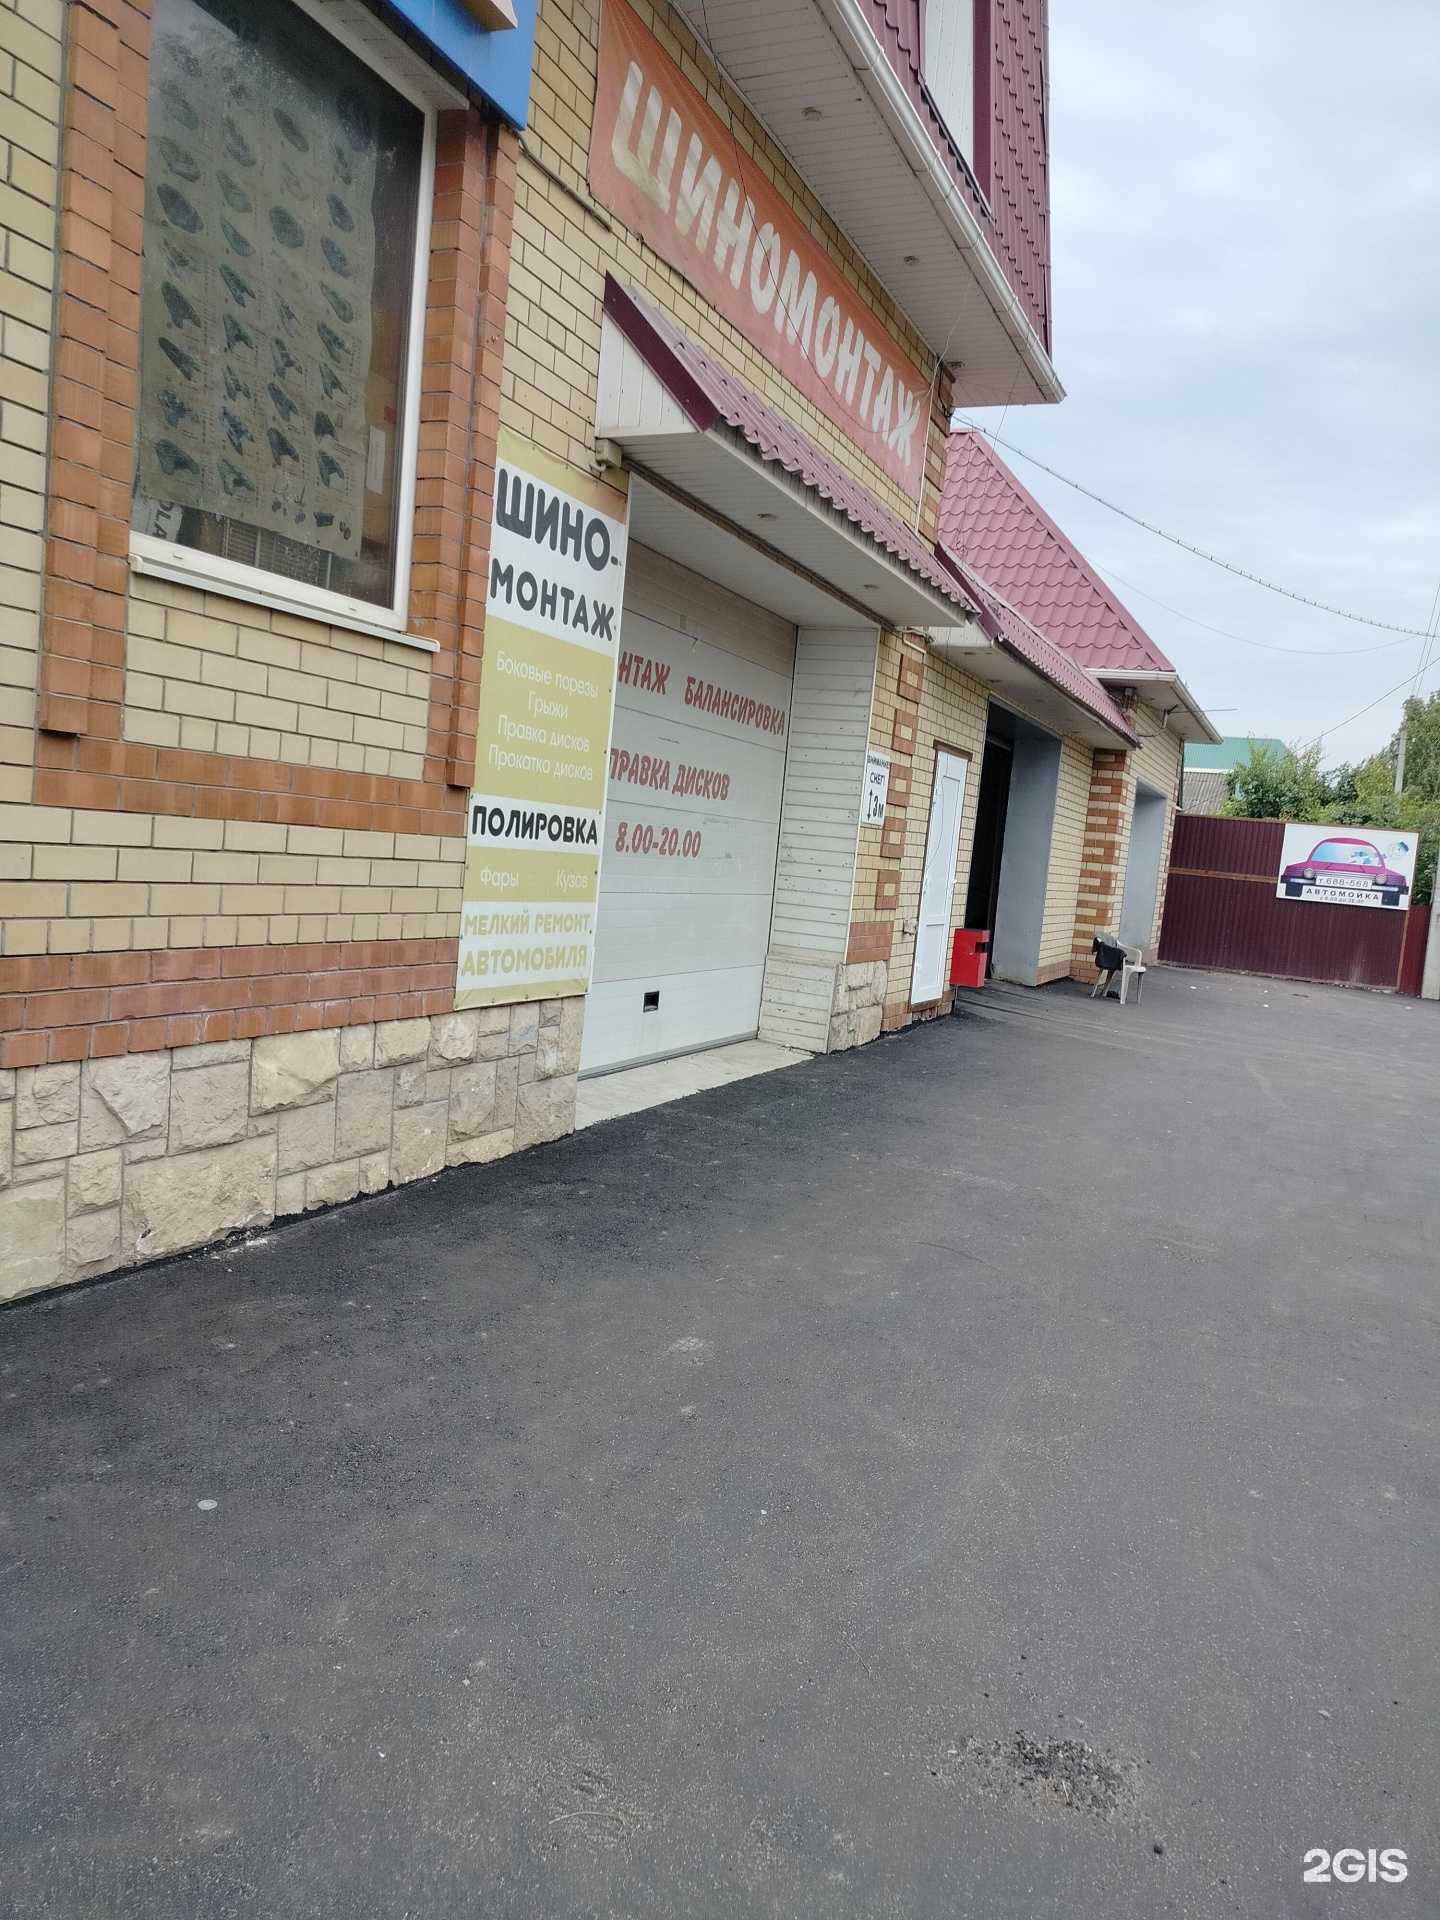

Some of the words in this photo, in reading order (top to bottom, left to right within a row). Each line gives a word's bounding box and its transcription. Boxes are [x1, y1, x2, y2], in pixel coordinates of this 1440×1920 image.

[612, 60, 921, 466] ШИНОМОНТАЖ
[496, 468, 618, 571] ШИНО-
[490, 558, 615, 641] МОНТАЖ
[496, 650, 552, 685] Боковые
[555, 673, 599, 698] порезы
[528, 690, 568, 718] Грыжи
[684, 676, 786, 736] БАЛАНСИРОВКА
[498, 714, 546, 745] Правка
[550, 732, 590, 752] дисков
[488, 743, 551, 771] Прокатка
[553, 763, 593, 781] дисков
[610, 748, 670, 791] ПРАВКА
[671, 764, 730, 801] ДИСКОВ
[472, 805, 598, 844] ПОЛИРОВКА
[615, 821, 702, 858] 8.00-20.00
[480, 866, 519, 893] Фары
[555, 869, 589, 893] Кузов
[464, 907, 530, 936] МЕЛКИЙ
[534, 913, 591, 934] РЕМОНТ
[461, 945, 588, 977] АВТОМОБИЛЯ
